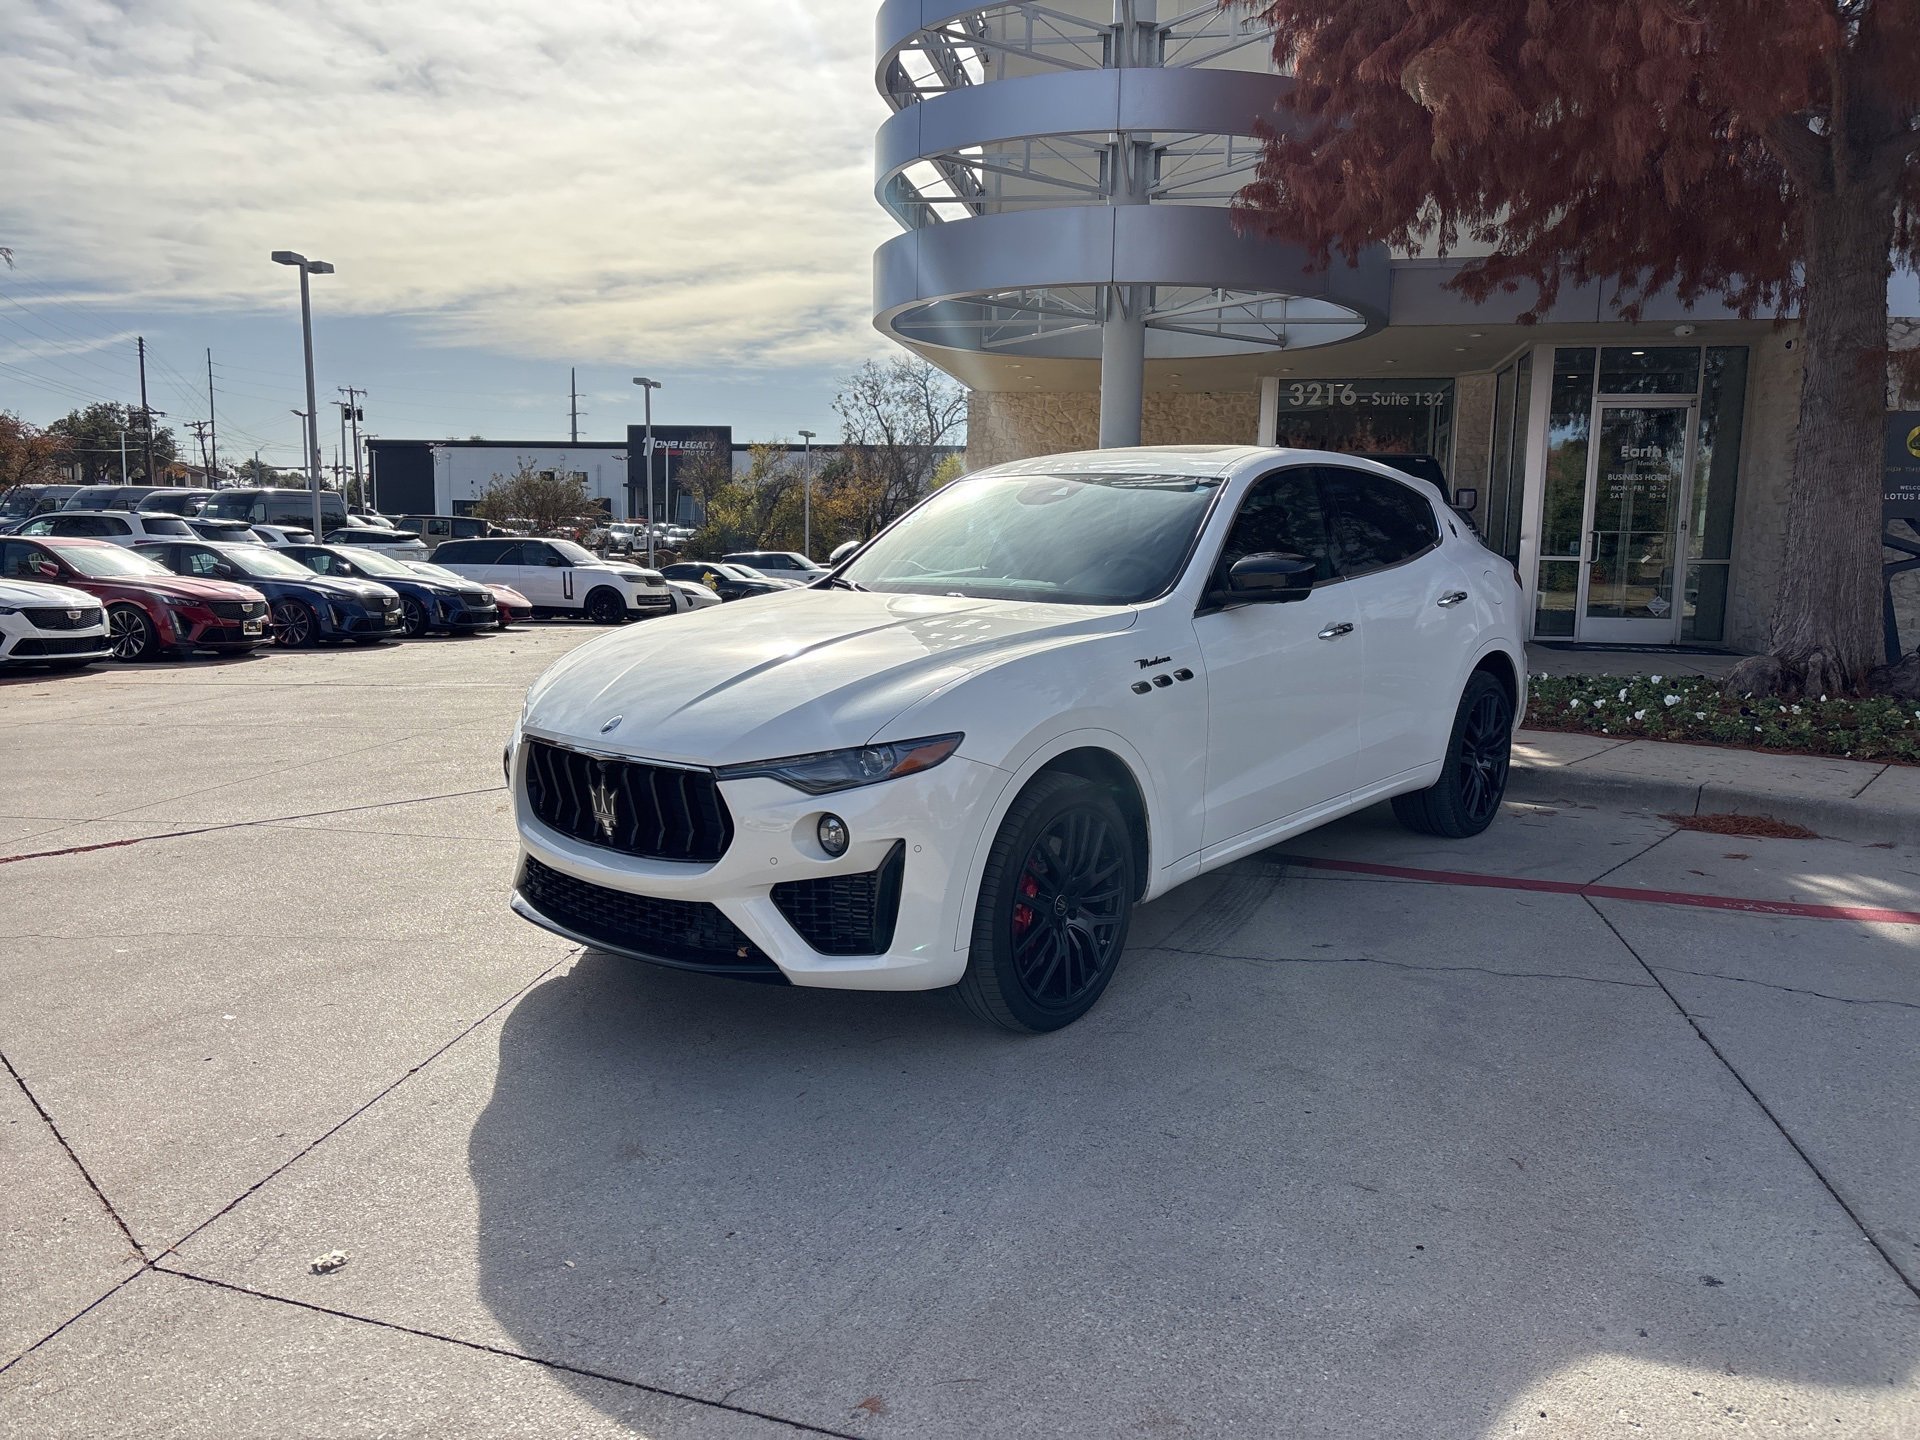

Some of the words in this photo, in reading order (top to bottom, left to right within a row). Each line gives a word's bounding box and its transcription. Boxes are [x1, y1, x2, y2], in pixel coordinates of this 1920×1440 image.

[1289, 383, 1357, 406] 3216
[1371, 392, 1409, 406] Suite
[1414, 392, 1444, 406] 132
[679, 440, 715, 449] LEGACY
[1621, 445, 1662, 458] Earth
[1607, 473, 1643, 481] BUSINESS
[1645, 473, 1672, 481] HOURS
